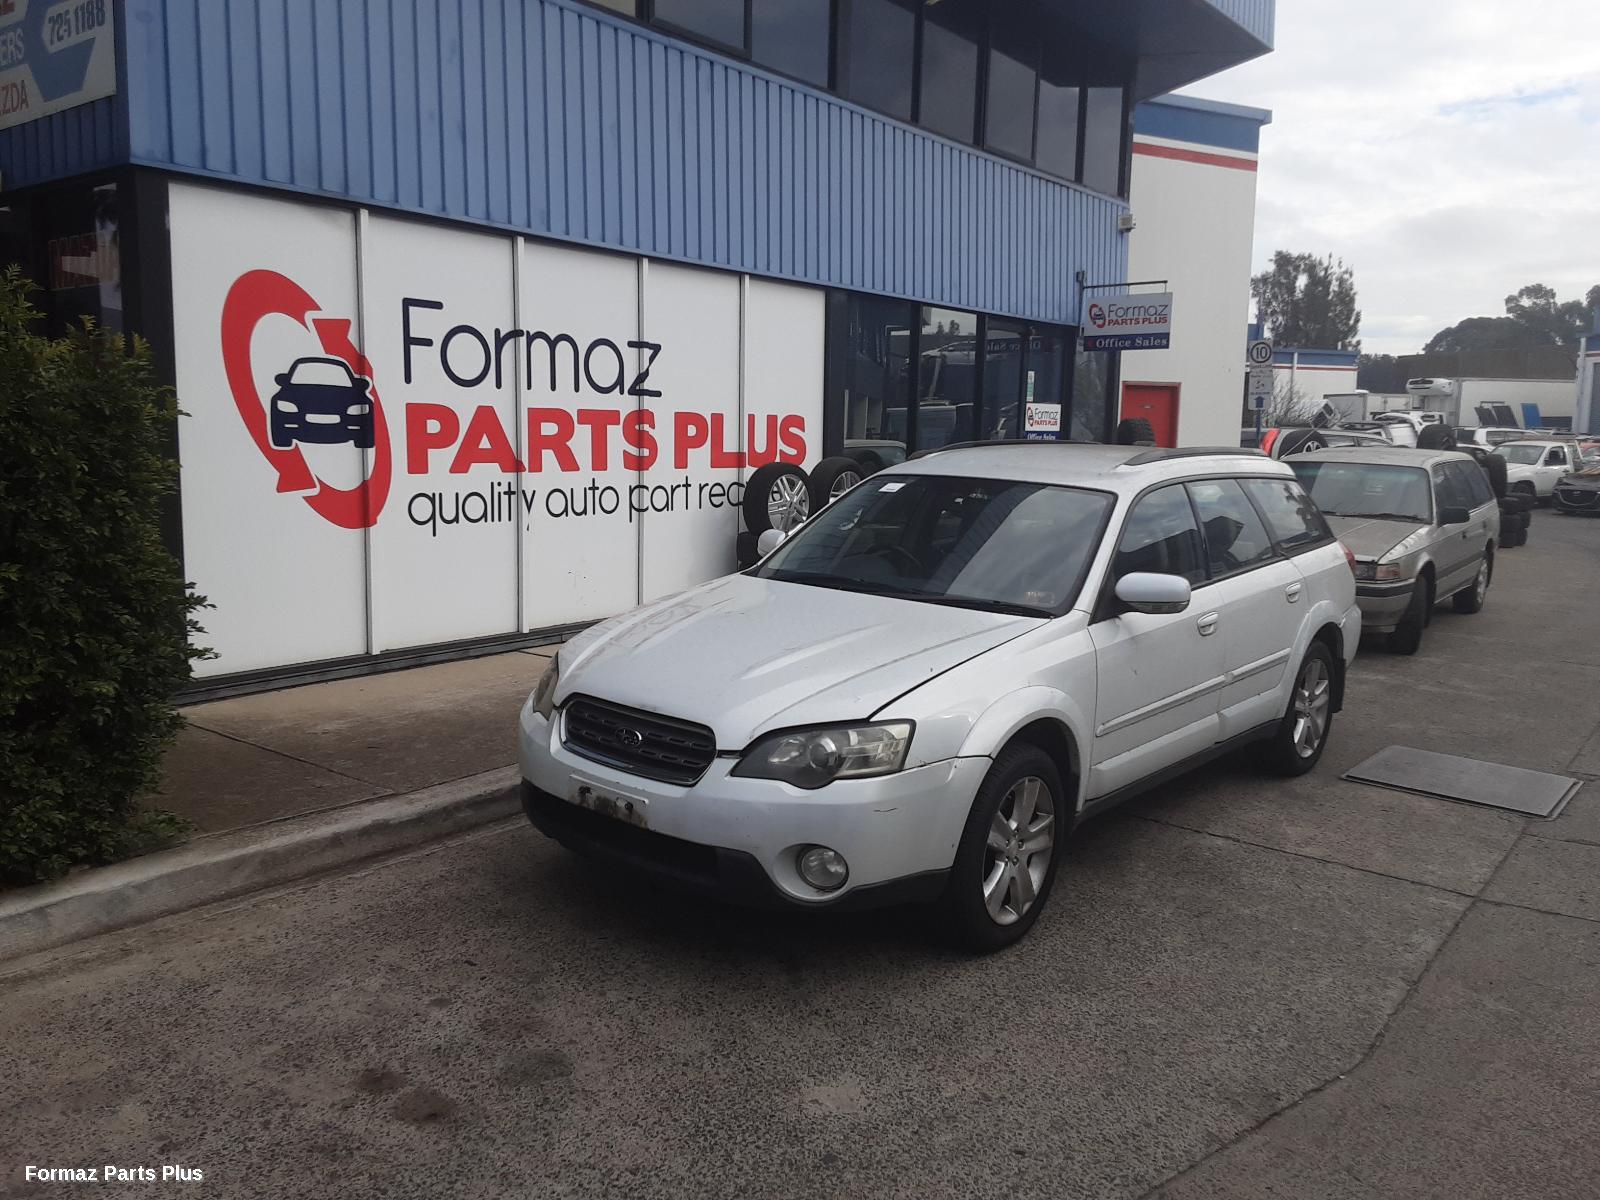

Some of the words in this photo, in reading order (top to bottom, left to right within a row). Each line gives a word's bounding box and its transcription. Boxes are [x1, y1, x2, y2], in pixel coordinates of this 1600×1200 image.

[0, 79, 29, 116] ZDA
[1108, 303, 1169, 319] Formaz
[1107, 317, 1140, 326] PARTS
[1142, 316, 1168, 325] PLUS
[402, 297, 662, 398] Formaz
[1096, 337, 1131, 349] Office
[1134, 336, 1168, 347] Sales
[1255, 346, 1268, 360] 10
[1034, 408, 1058, 420] Formaz
[405, 402, 659, 475] PARTS
[673, 411, 807, 470] PLUS
[407, 481, 536, 537] quality
[545, 478, 620, 518] auto
[629, 476, 692, 523] part
